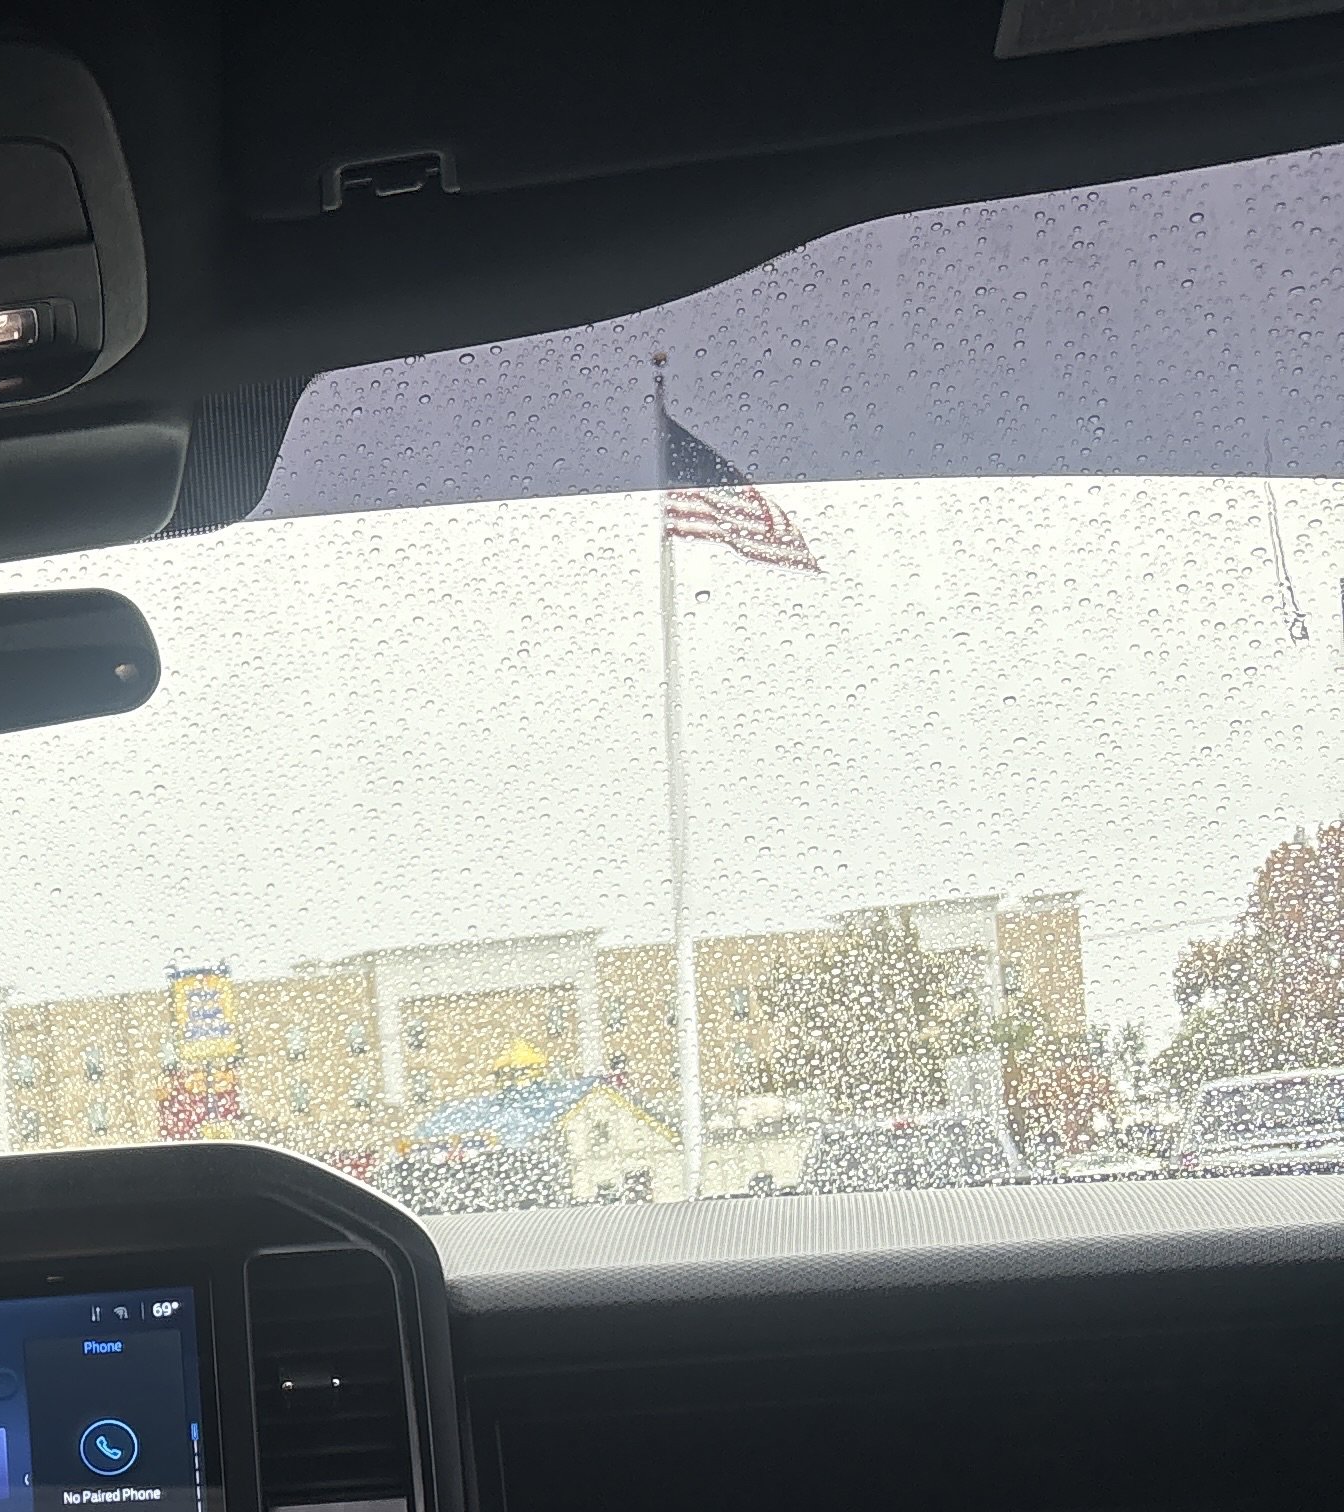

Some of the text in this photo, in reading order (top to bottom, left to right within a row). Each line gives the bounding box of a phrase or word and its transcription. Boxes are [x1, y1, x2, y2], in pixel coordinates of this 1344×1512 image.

[83, 1340, 123, 1354] Phone
[63, 1487, 162, 1505] No Paired Phone
